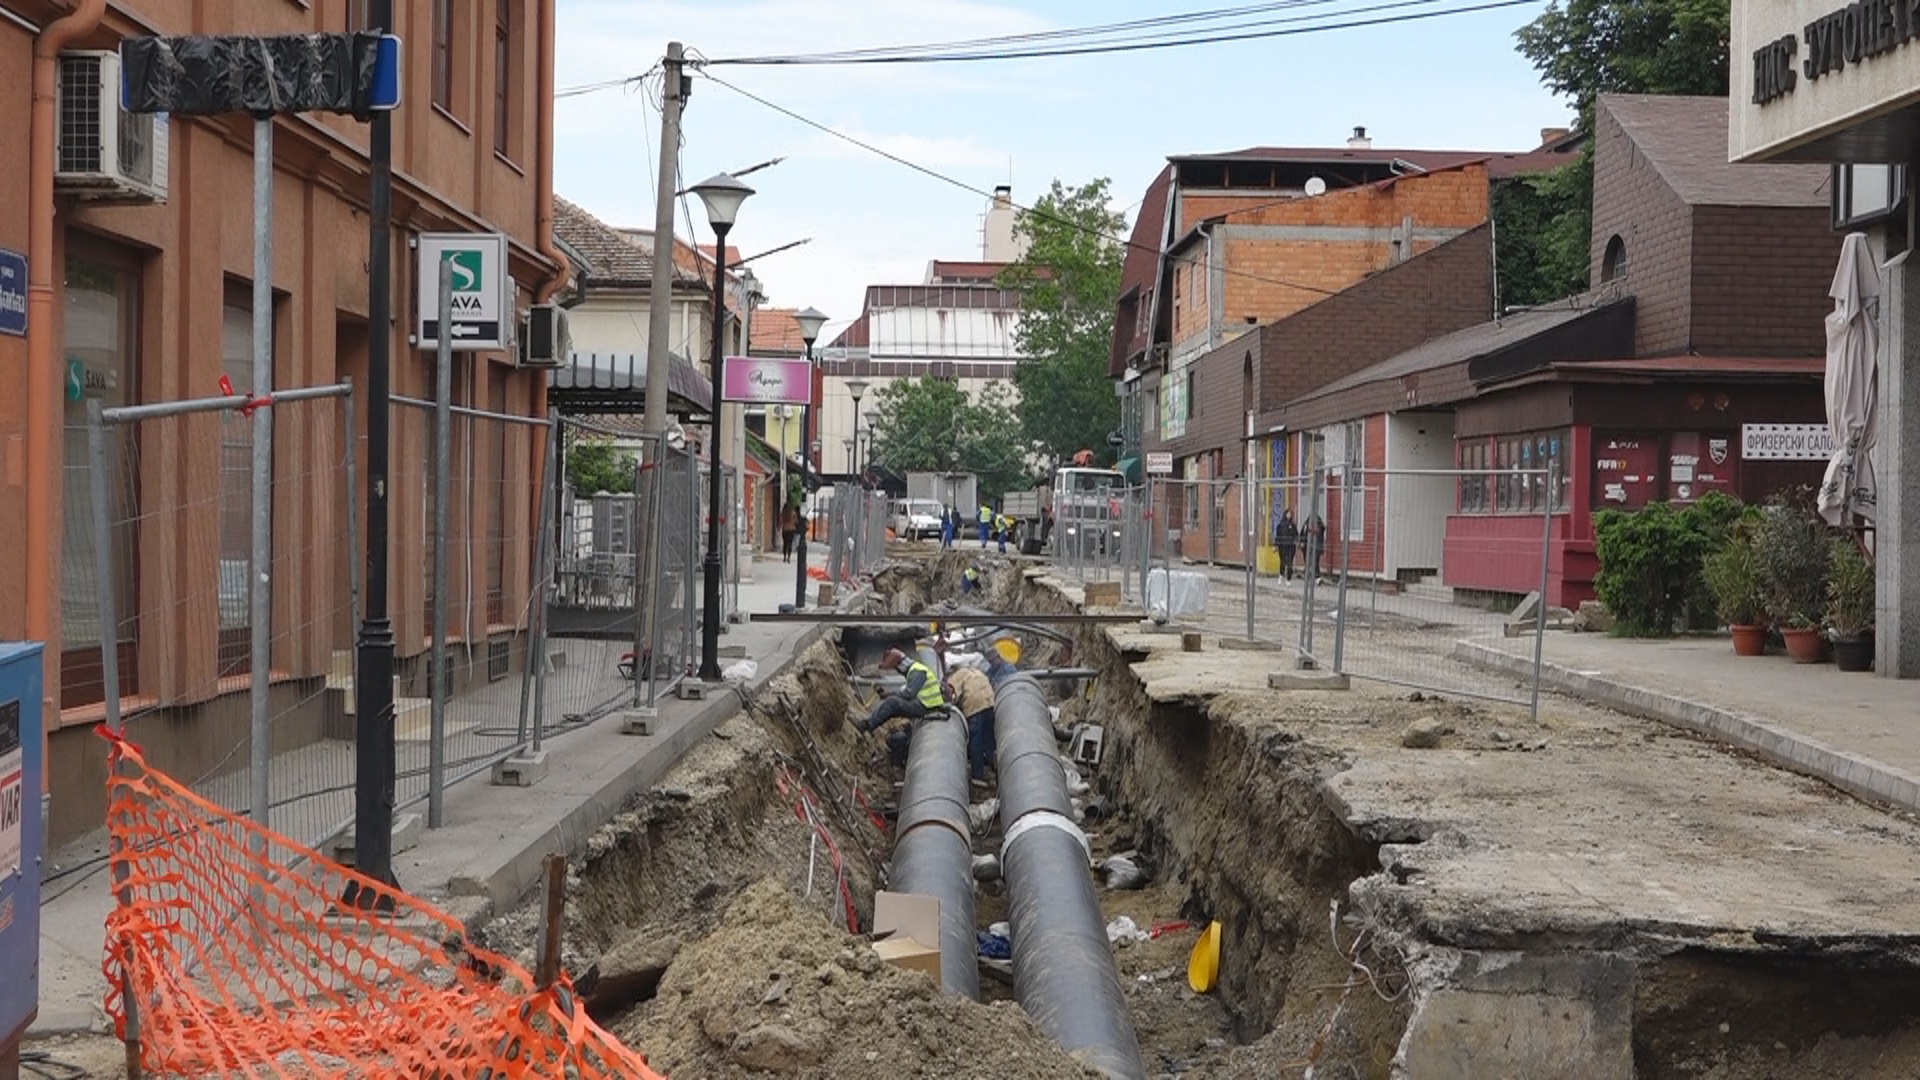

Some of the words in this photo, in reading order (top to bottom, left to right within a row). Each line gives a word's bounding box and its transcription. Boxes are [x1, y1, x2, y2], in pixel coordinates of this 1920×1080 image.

[451, 296, 482, 310] AVA
[85, 369, 107, 390] SAVA
[1747, 433, 1805, 451] ФРИЗЕРСКИ
[1807, 435, 1837, 451] САЛО
